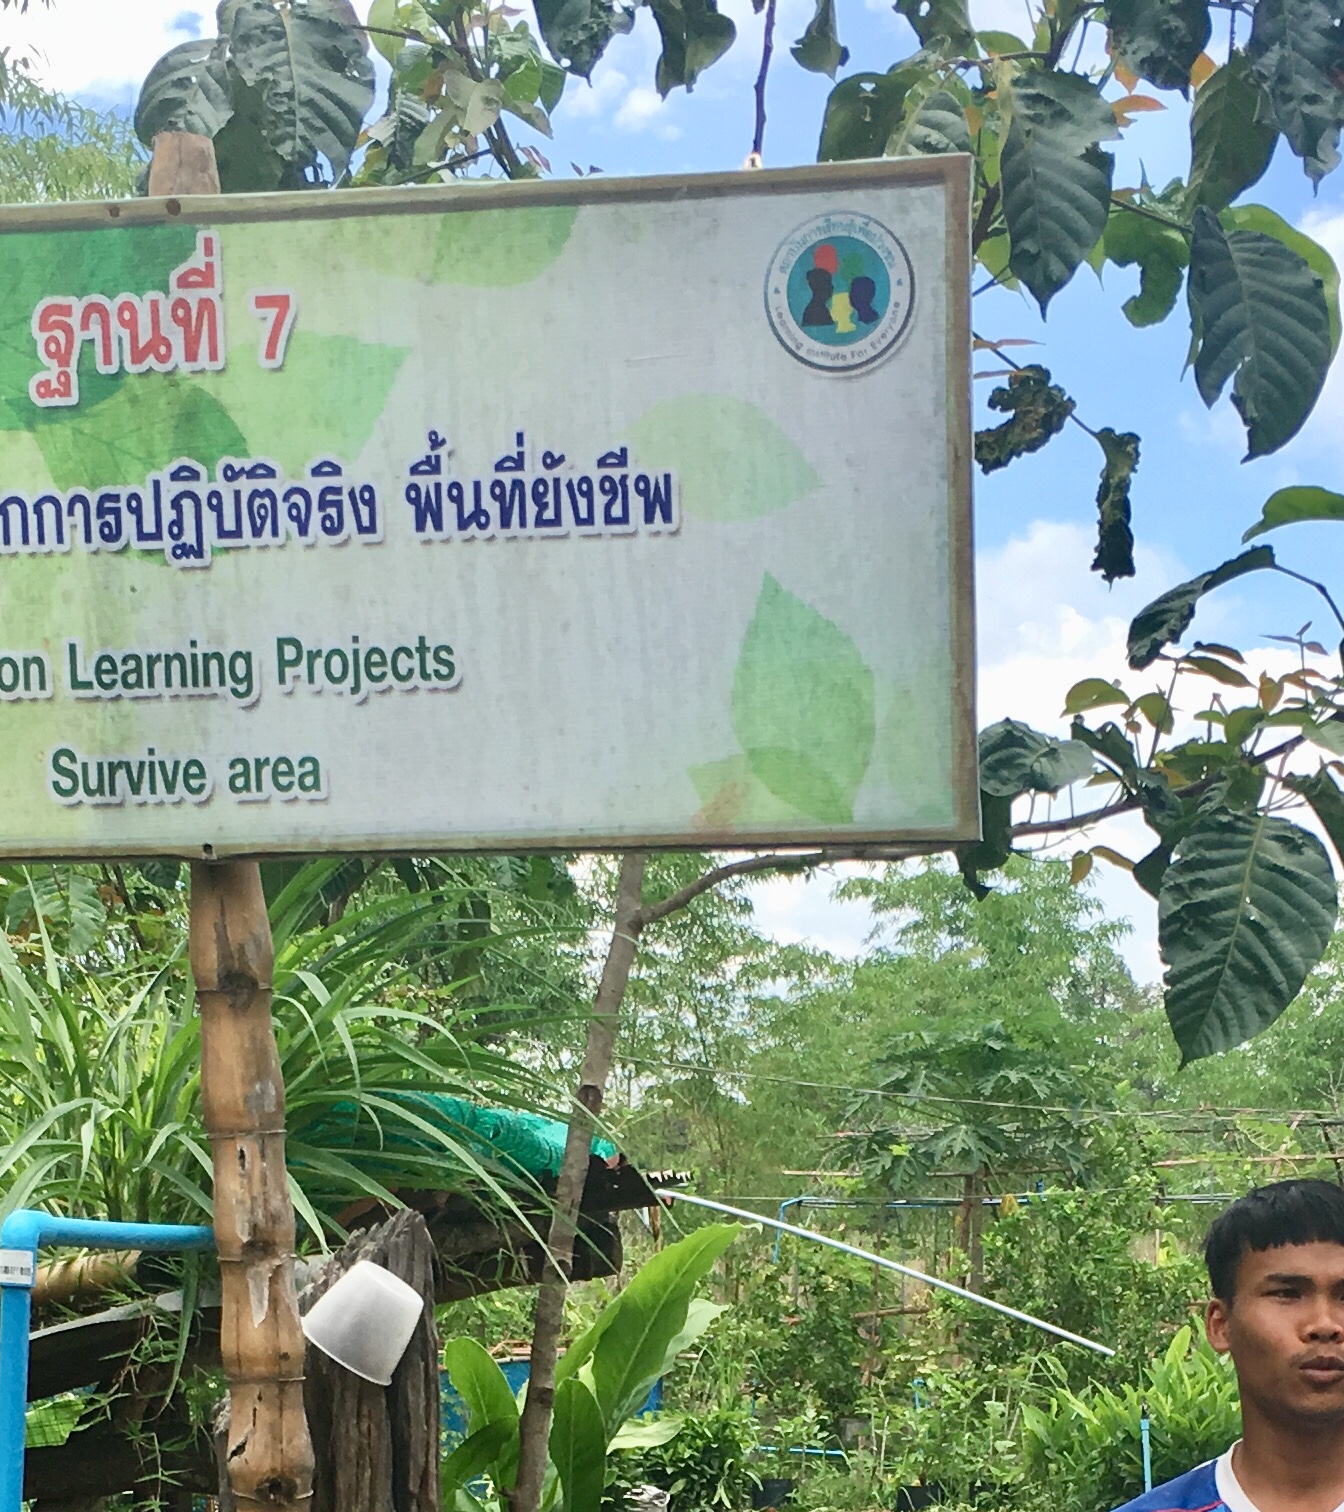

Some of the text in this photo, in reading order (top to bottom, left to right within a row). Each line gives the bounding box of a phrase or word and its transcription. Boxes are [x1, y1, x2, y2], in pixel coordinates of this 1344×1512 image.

[35, 236, 291, 399] ฐานที่ 7
[404, 429, 676, 534] พื้นที่ยังชีพ
[67, 640, 254, 700] Learning
[275, 635, 457, 696] Projects
[51, 747, 323, 798] Survive area
